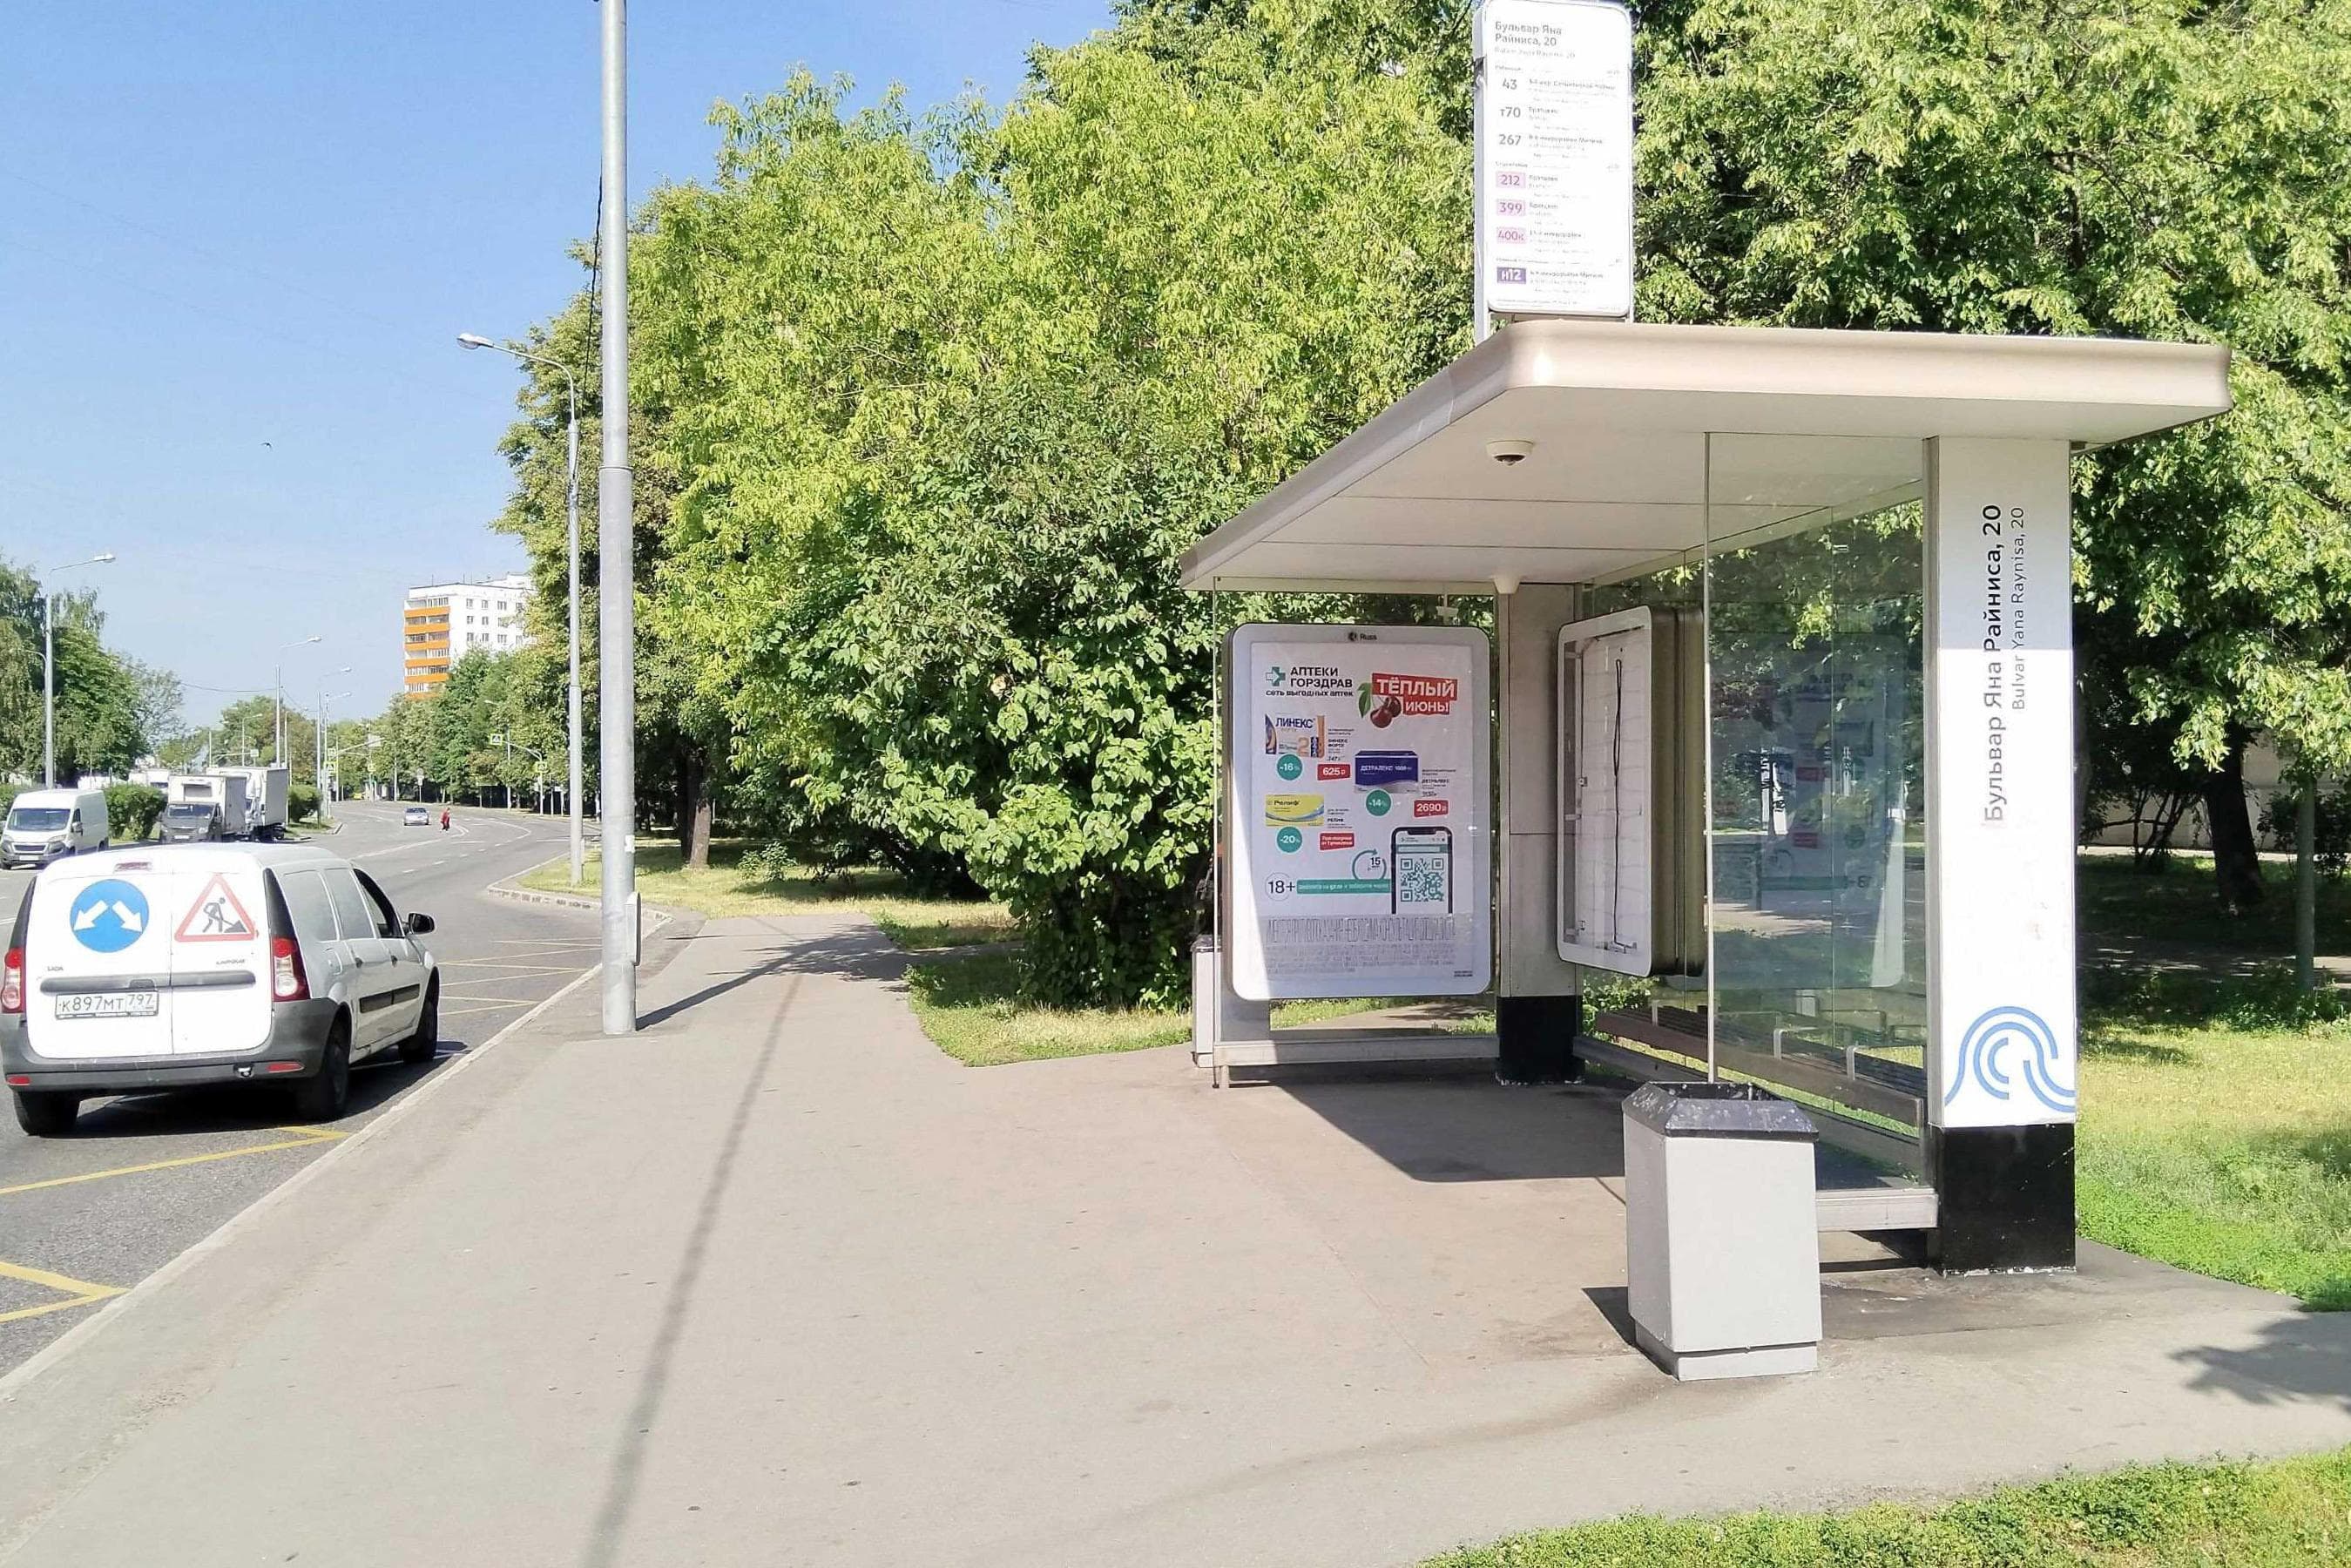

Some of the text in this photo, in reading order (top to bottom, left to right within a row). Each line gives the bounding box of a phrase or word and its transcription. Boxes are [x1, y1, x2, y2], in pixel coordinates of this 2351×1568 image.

[1495, 21, 1562, 36] Бульвар Яна
[1544, 37, 1557, 46] 20
[1502, 78, 1517, 90] 43
[1499, 134, 1522, 145] 267
[1501, 174, 1520, 186] 212
[1499, 202, 1523, 214] 399
[2011, 507, 2027, 710] Bulvar Yana Raynisa, 20
[1983, 504, 2007, 821] Бульвар Яна Райниса, 20
[1290, 666, 1339, 677] АПТЕКИ
[1290, 678, 1353, 689] ГОРЗДРАВ
[1376, 677, 1455, 698] ТЁПЛЫЙ
[1275, 717, 1314, 728] ЛИНЕКС
[1267, 880, 1295, 894] 18+
